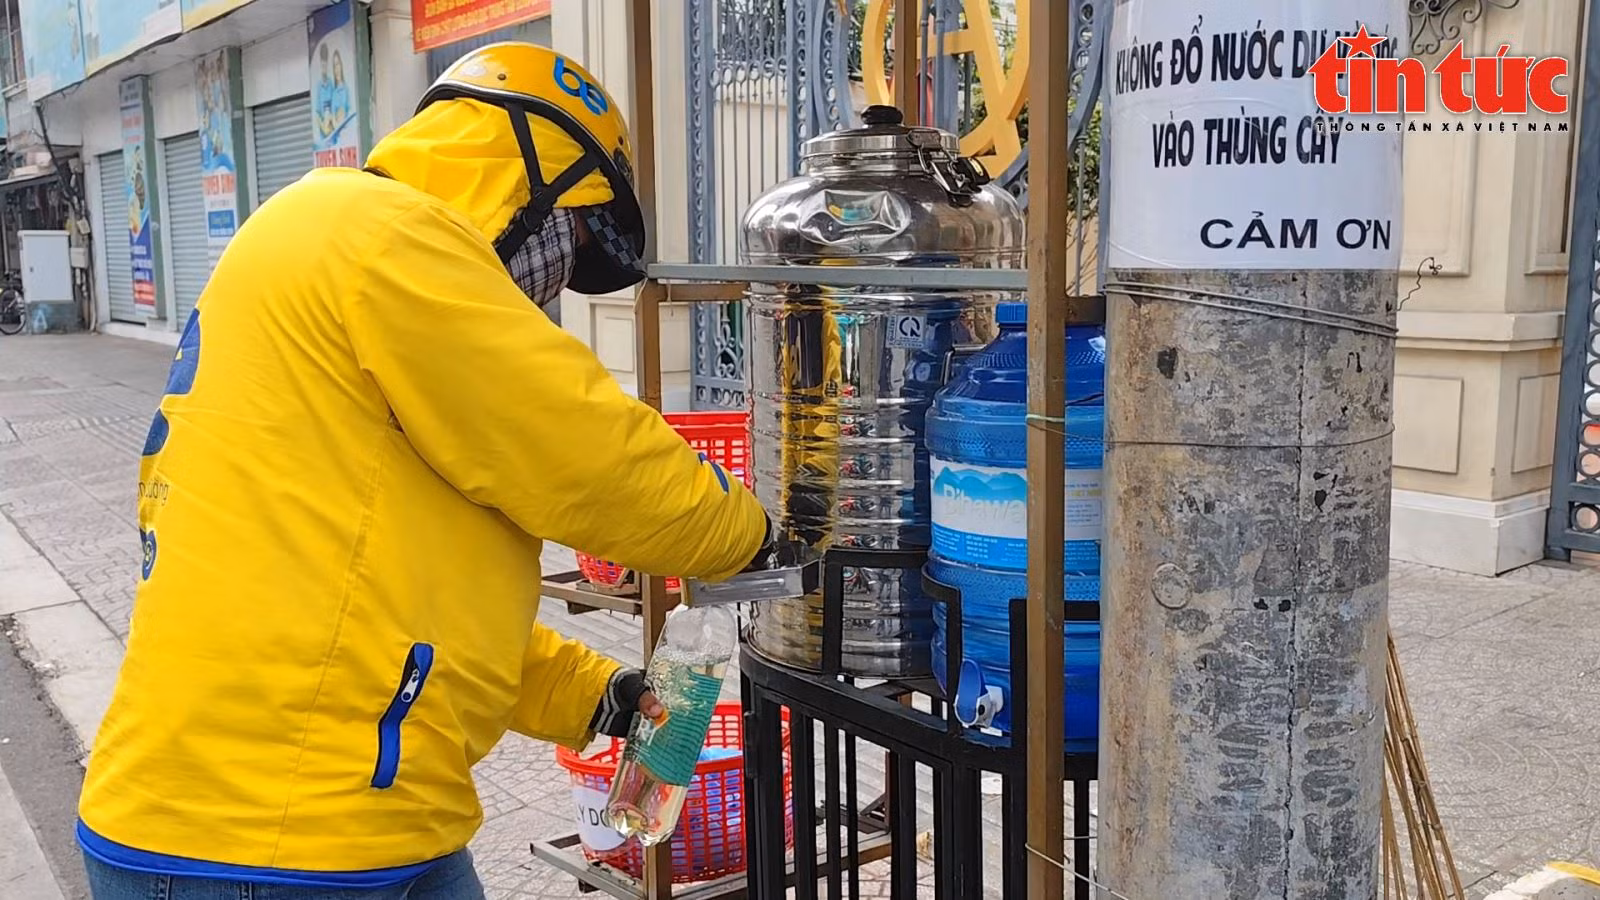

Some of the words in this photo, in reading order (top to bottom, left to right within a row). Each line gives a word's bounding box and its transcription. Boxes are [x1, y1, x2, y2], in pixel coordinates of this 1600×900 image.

[554, 55, 609, 116] be
[1115, 35, 1164, 96] KHÔNG
[1170, 14, 1204, 86] ĐỔ
[1210, 19, 1285, 82] NƯỚC
[1152, 110, 1195, 169] VÀO
[1203, 105, 1287, 166] THÙNG
[1200, 210, 1318, 249] CẢM
[1336, 218, 1391, 250] ƠN
